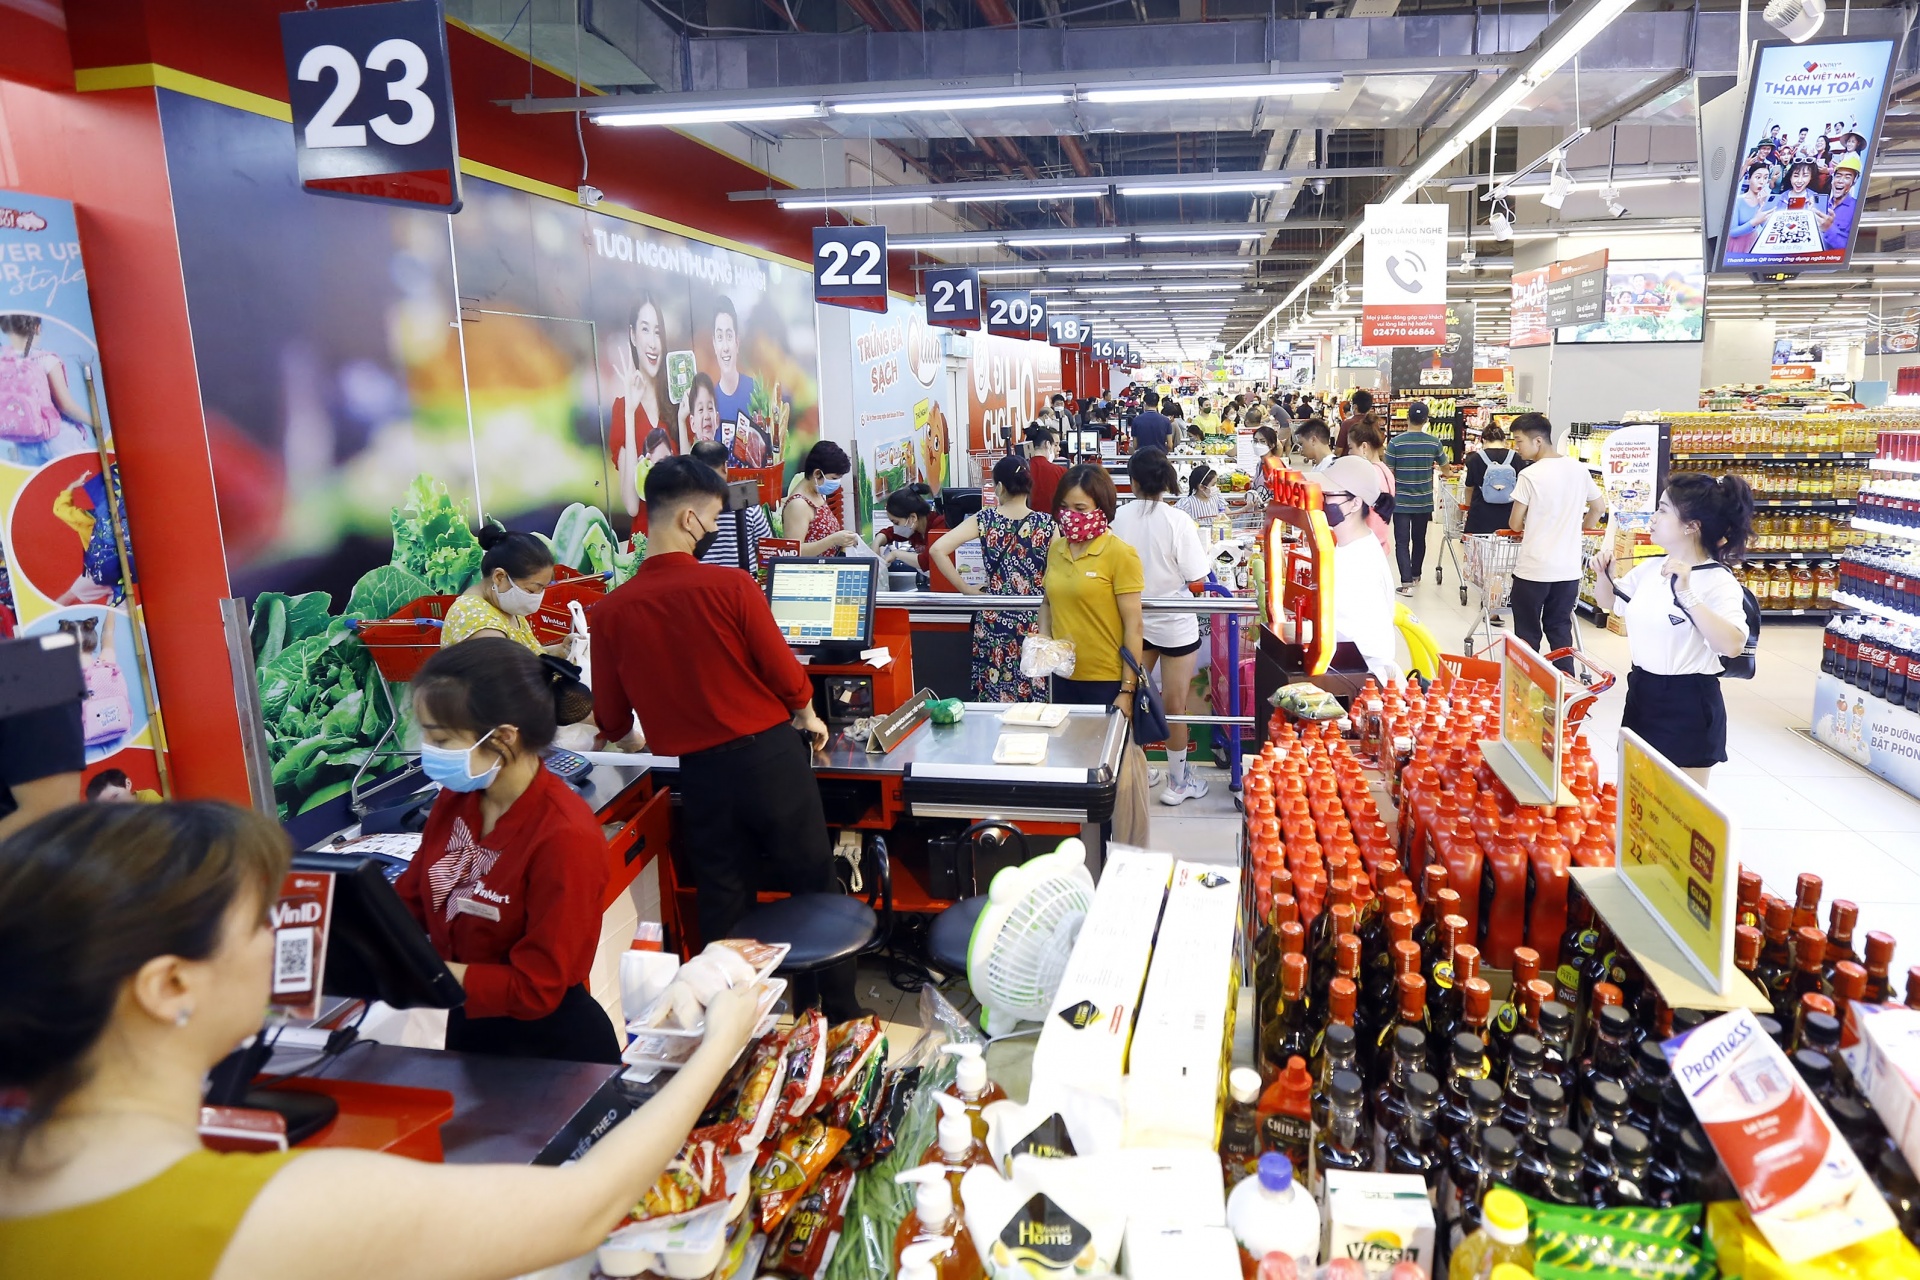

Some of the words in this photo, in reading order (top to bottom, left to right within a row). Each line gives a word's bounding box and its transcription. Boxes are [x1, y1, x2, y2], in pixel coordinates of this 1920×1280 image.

[1764, 82, 1822, 96] THANH
[1827, 76, 1875, 95] TOÁN
[1785, 73, 1810, 82] CÁCH
[1812, 72, 1832, 81] VIỆT
[1834, 72, 1855, 80] NAM
[297, 38, 436, 149] 23
[1419, 227, 1443, 235] NGHE
[48, 242, 82, 261] UP
[635, 238, 681, 273] NGON
[818, 240, 882, 286] 22
[9, 259, 86, 308] style
[931, 279, 974, 313] 21
[989, 299, 1029, 325] 20
[1030, 304, 1043, 328] 9
[1052, 320, 1077, 340] 18
[1080, 326, 1091, 342] 7
[1373, 328, 1406, 336] 024710
[1407, 328, 1436, 336] 66866
[1093, 342, 1113, 357] 16
[1116, 345, 1126, 358] 4
[1130, 353, 1138, 364] 2
[871, 358, 898, 394] SẠCH
[777, 549, 798, 557] VinID
[1871, 722, 1889, 735] NẠP
[1890, 728, 1920, 744] DƯỠNG
[1871, 735, 1890, 751] BẬT
[1630, 797, 1643, 821] 99
[1630, 839, 1643, 865] 22
[1694, 838, 1712, 861] GIẢM
[270, 901, 322, 928] VinID
[570, 1136, 592, 1160] TIẾP
[590, 1108, 618, 1138] THEO
[1267, 1118, 1311, 1139] CHIN-SU
[1019, 1220, 1073, 1246] Home
